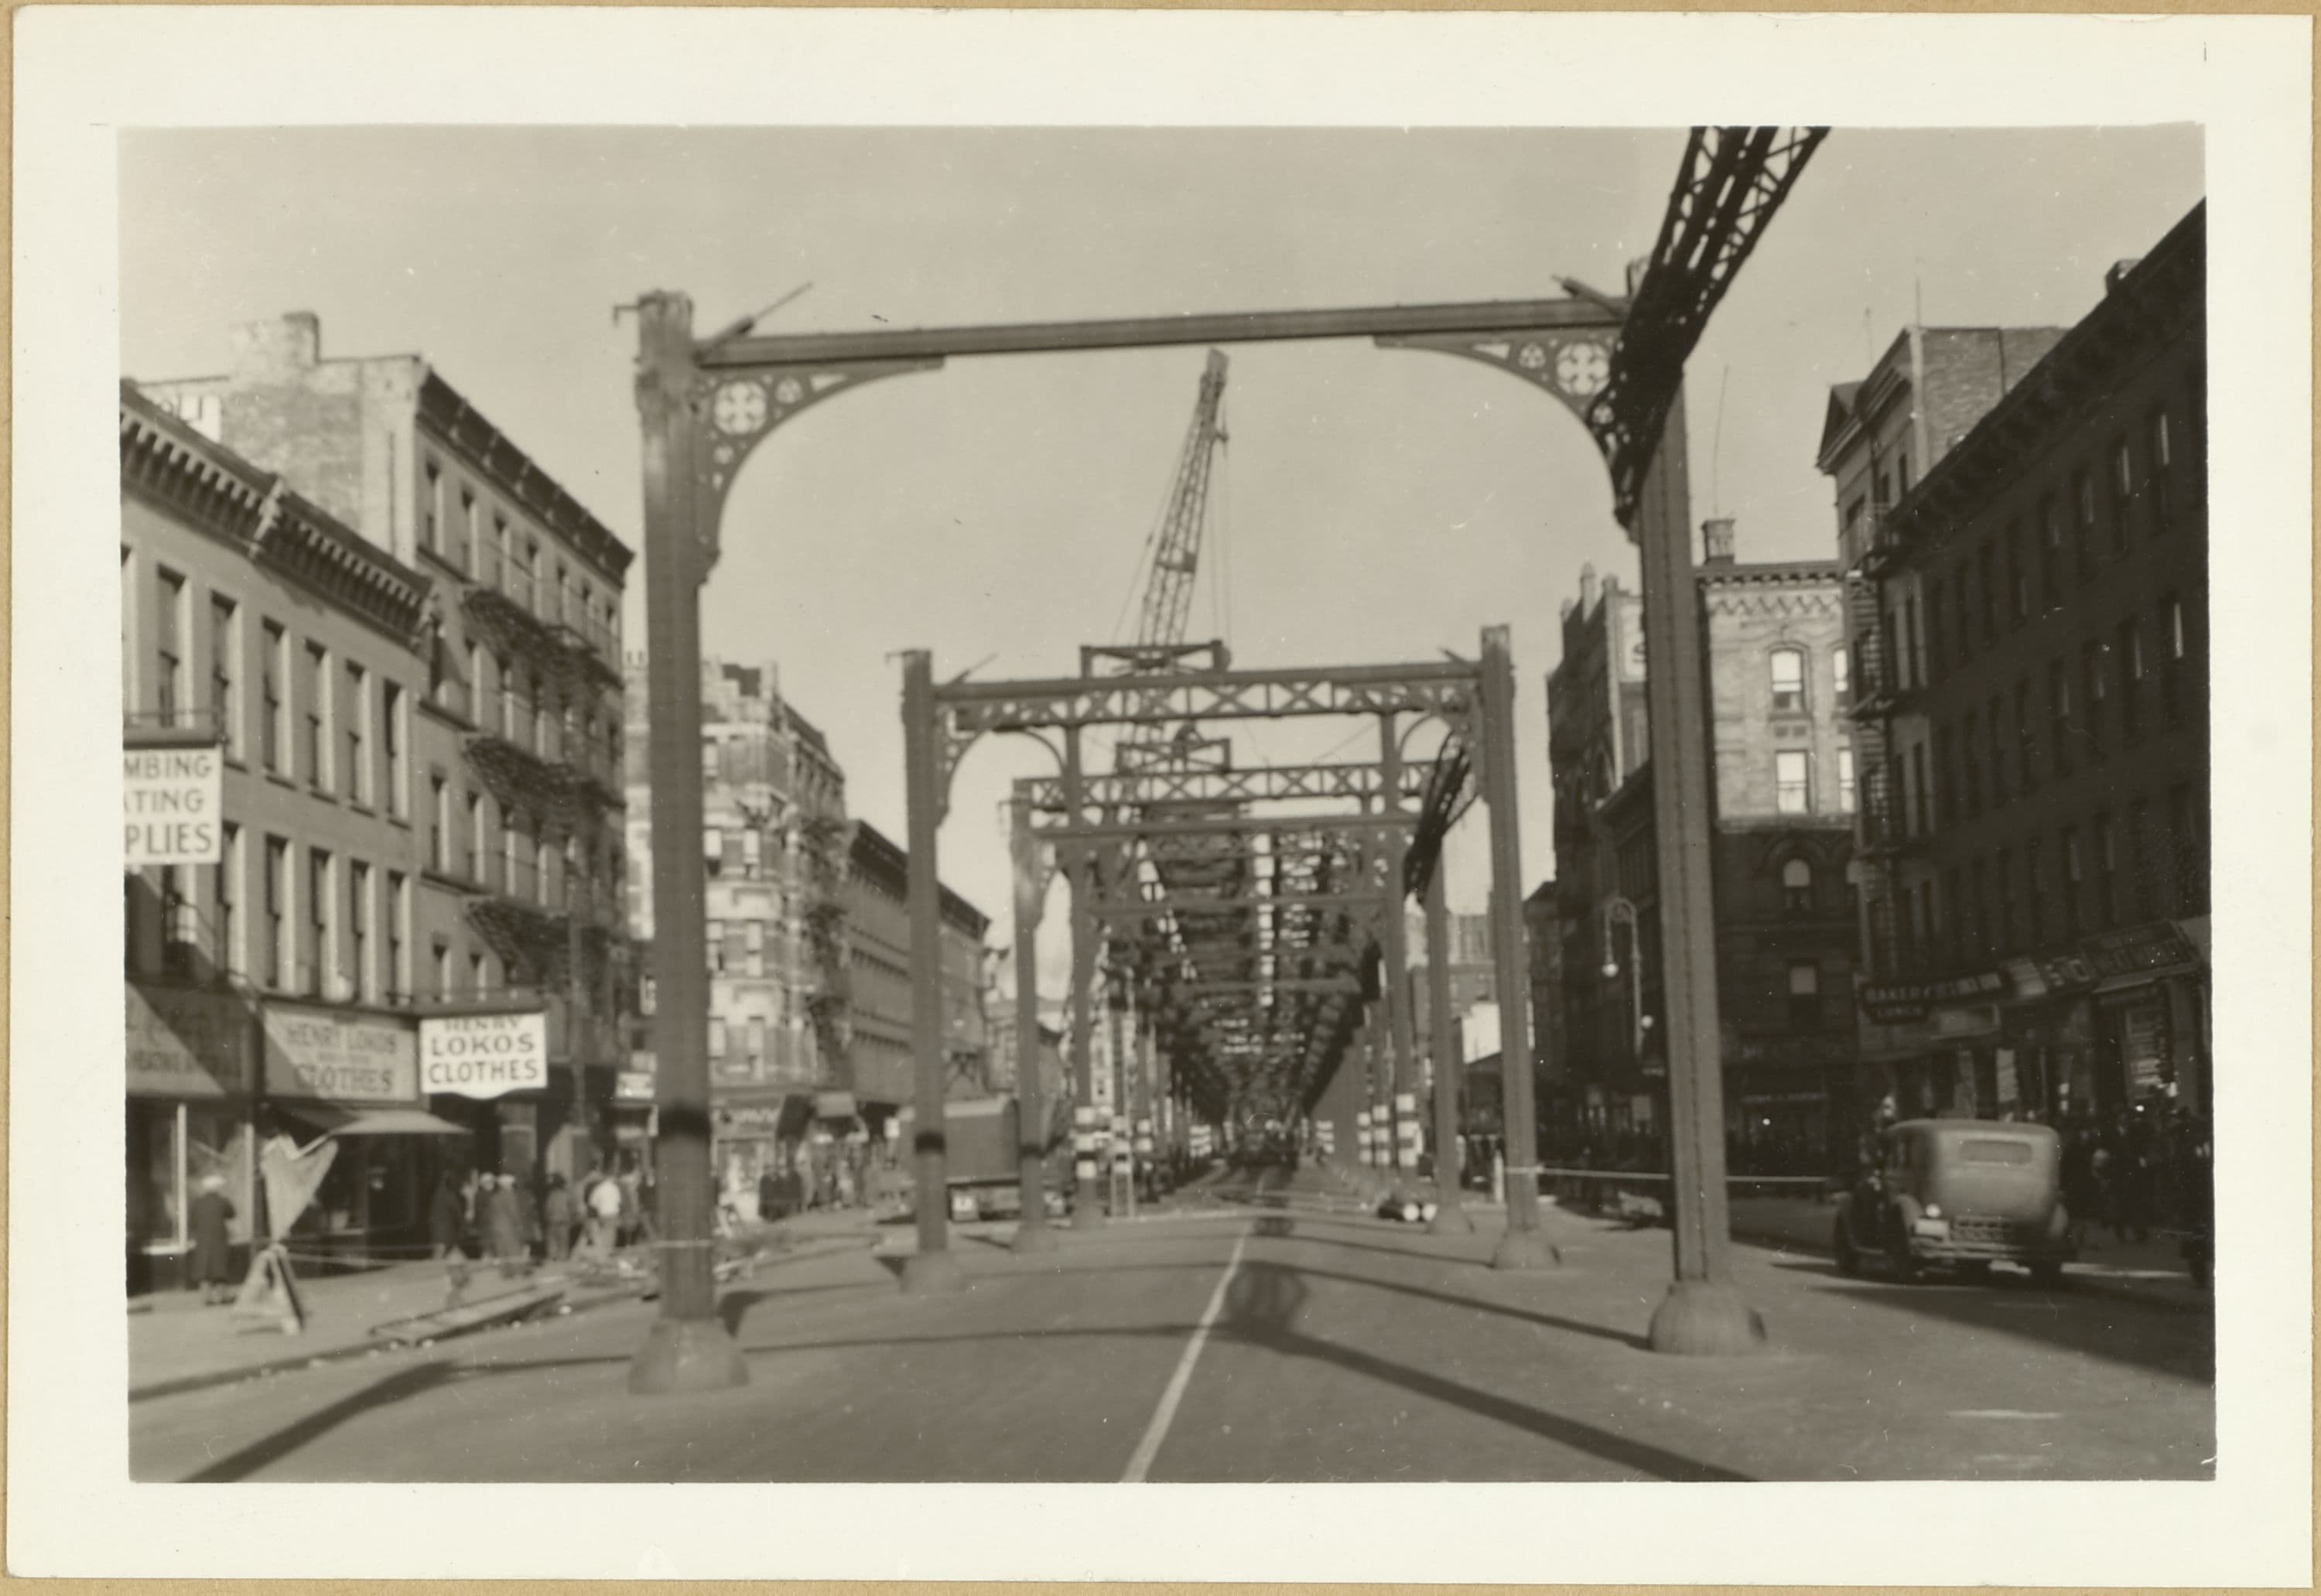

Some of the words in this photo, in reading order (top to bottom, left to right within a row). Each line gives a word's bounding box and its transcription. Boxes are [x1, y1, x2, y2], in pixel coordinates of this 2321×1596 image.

[124, 755, 211, 778] MBING
[125, 822, 211, 854] PLIES
[431, 1033, 535, 1056] LOKOS
[429, 1059, 538, 1084] CLOTHES
